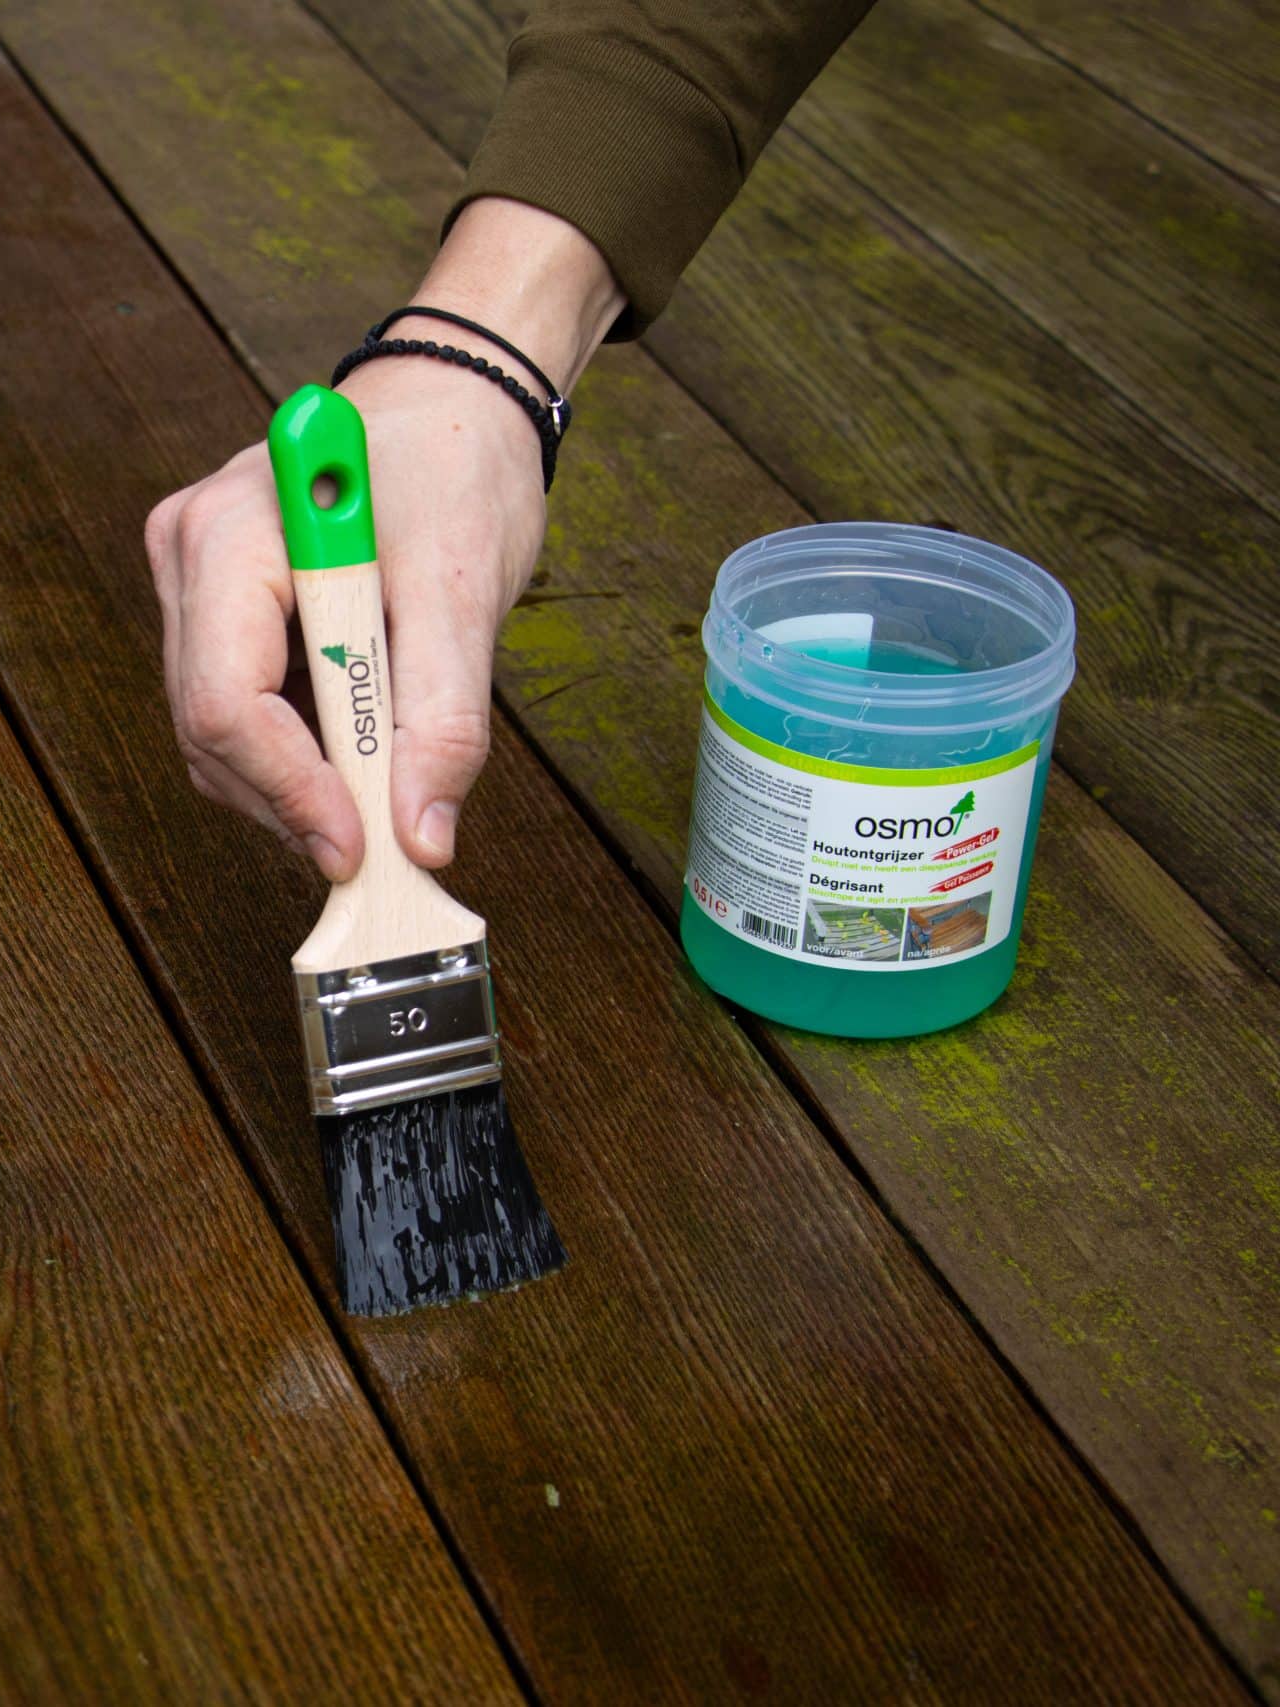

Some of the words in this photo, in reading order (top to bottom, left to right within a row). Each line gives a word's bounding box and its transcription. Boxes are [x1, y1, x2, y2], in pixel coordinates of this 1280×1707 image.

[349, 661, 378, 755] osmo
[855, 816, 955, 839] osmo
[813, 840, 924, 863] Houtontgrijzer
[946, 829, 995, 859] Power-Gel
[874, 863, 898, 872] heeft
[810, 873, 884, 893] Dégrisant
[806, 943, 865, 959] voor/avant
[390, 1007, 428, 1037] 50
